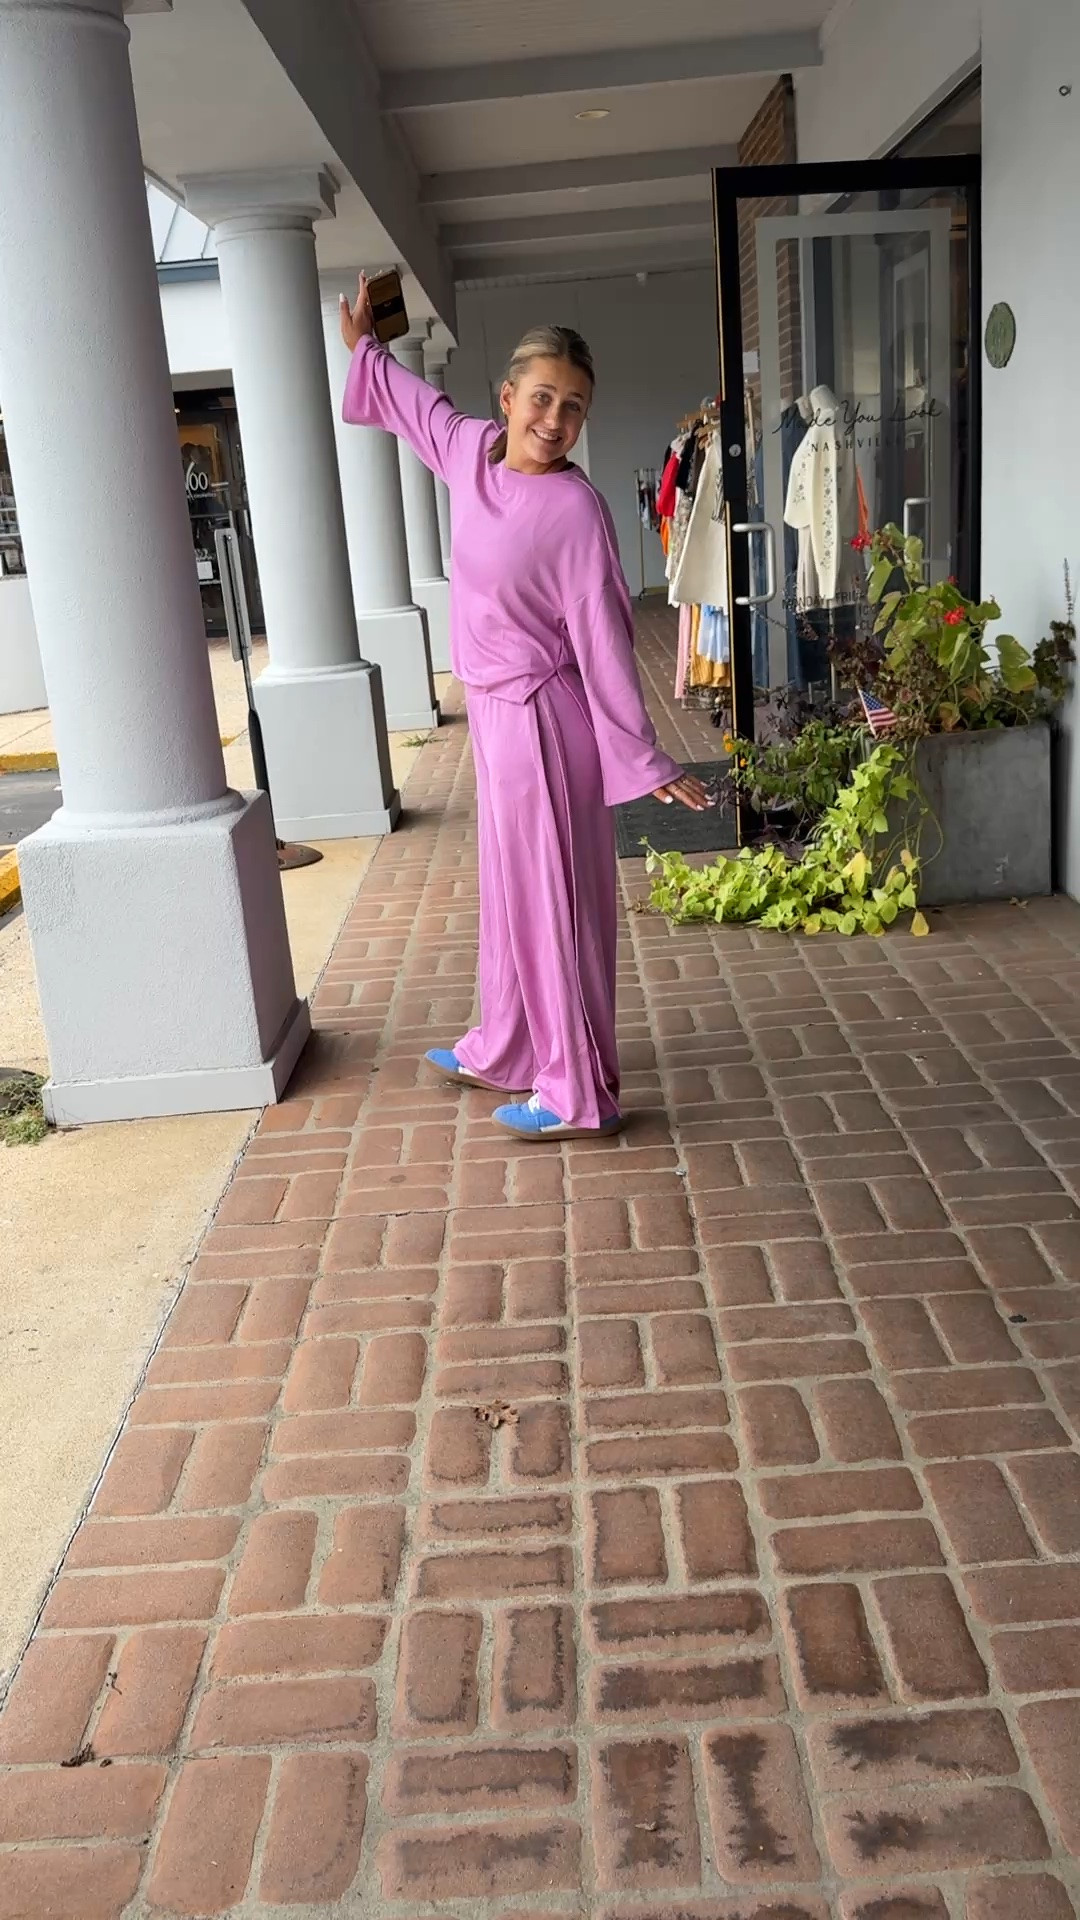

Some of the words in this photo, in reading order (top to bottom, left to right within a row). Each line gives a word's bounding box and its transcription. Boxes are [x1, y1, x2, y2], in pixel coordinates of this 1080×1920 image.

[772, 404, 837, 434] Made
[841, 399, 881, 436] You
[887, 397, 943, 422] Look
[811, 436, 901, 452] NASHVILLE
